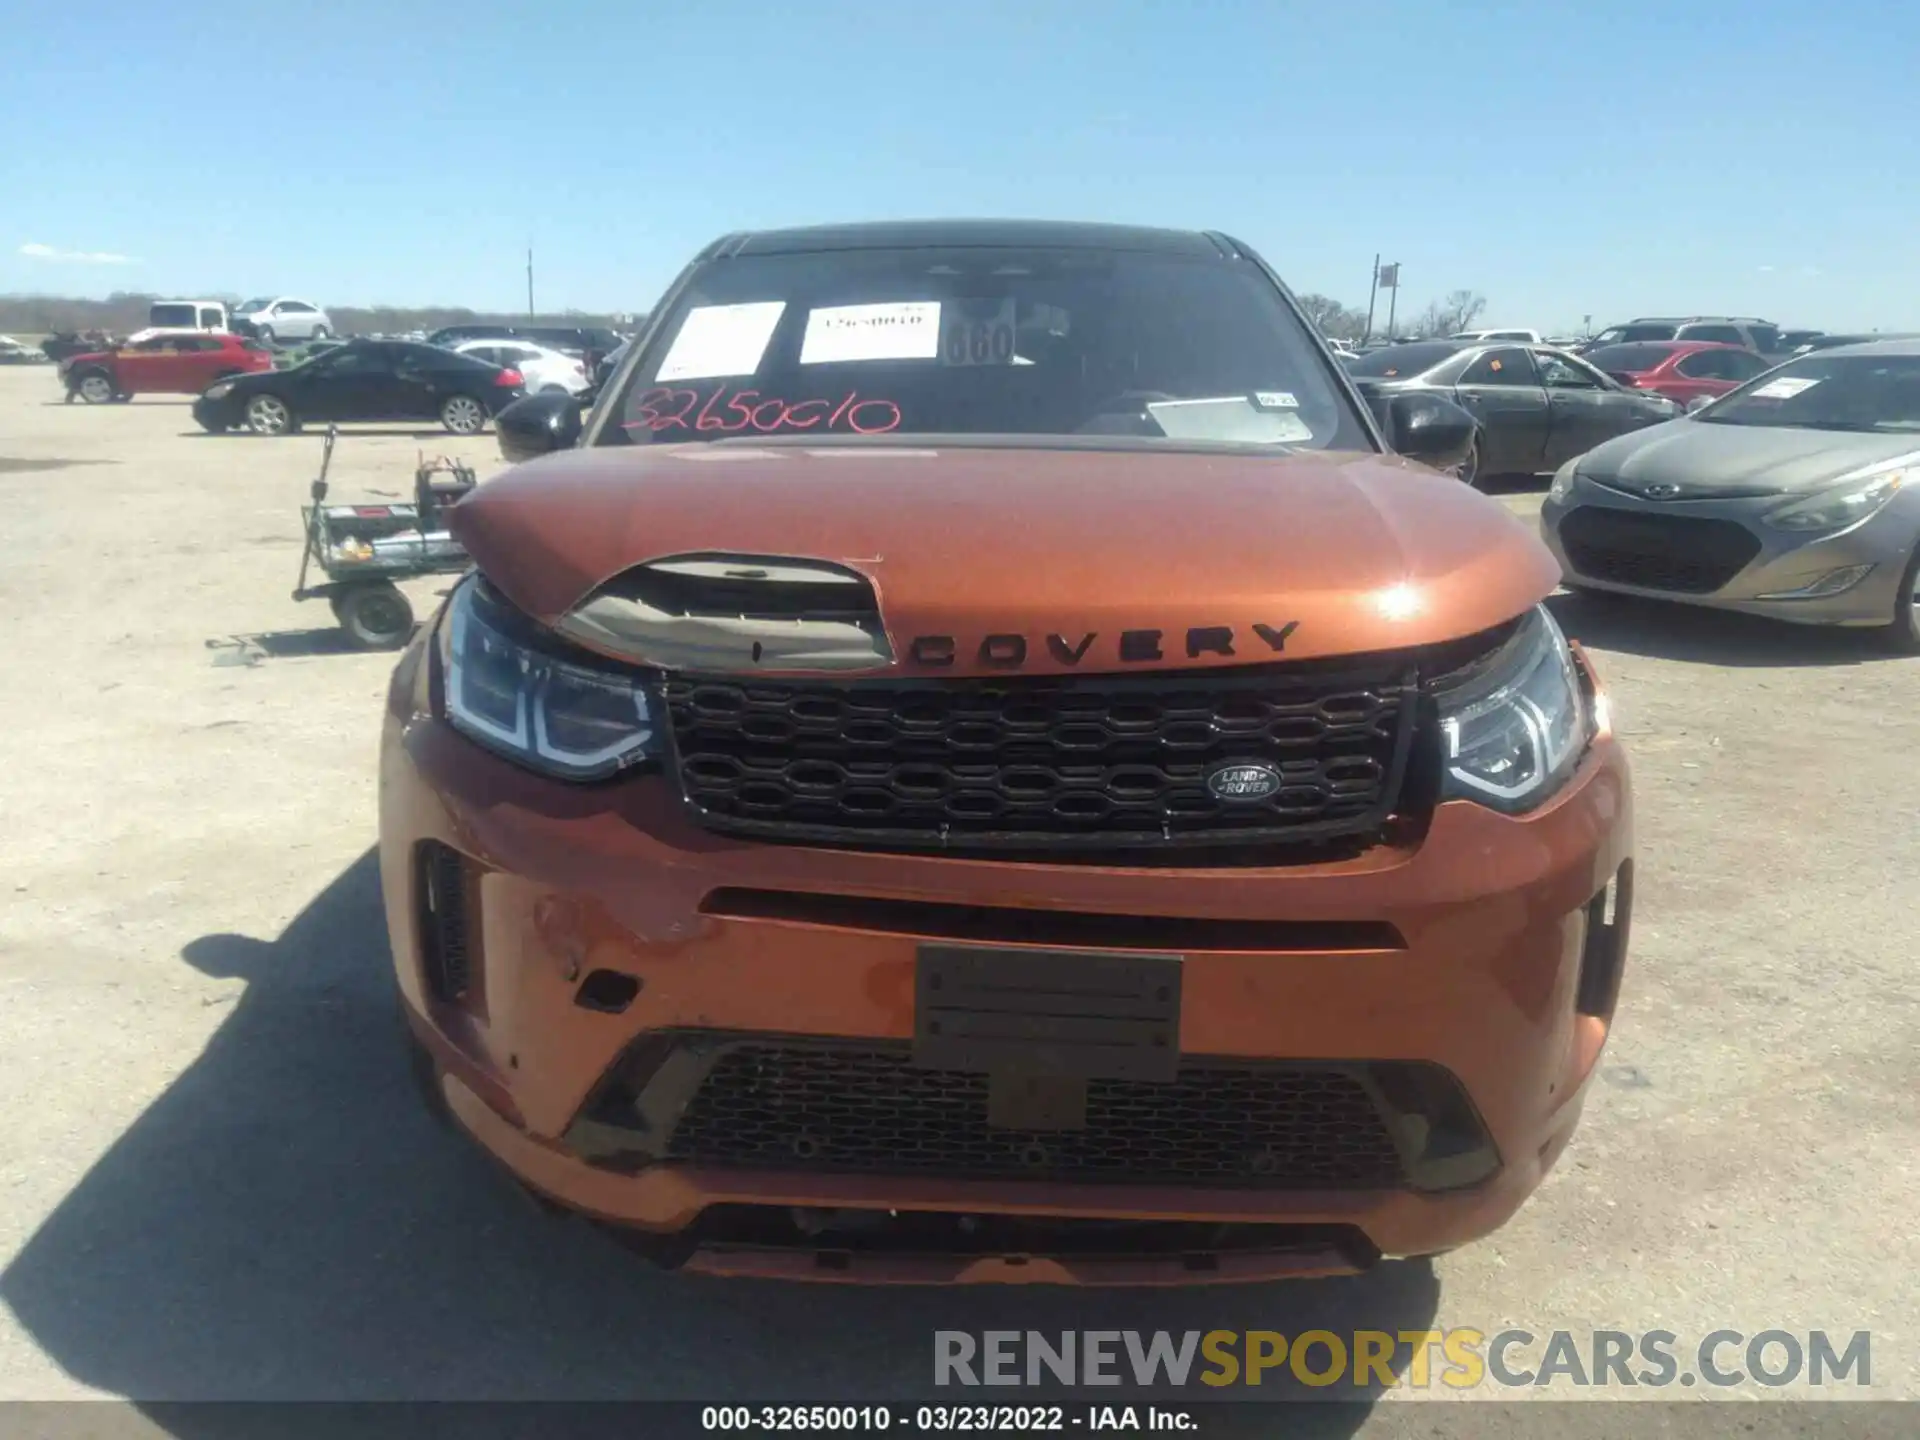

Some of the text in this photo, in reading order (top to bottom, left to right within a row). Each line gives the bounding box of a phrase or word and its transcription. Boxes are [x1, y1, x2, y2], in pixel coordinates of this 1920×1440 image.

[911, 621, 1299, 667] COVERY
[1222, 771, 1258, 782] LAND
[1226, 782, 1270, 793] ROVER
